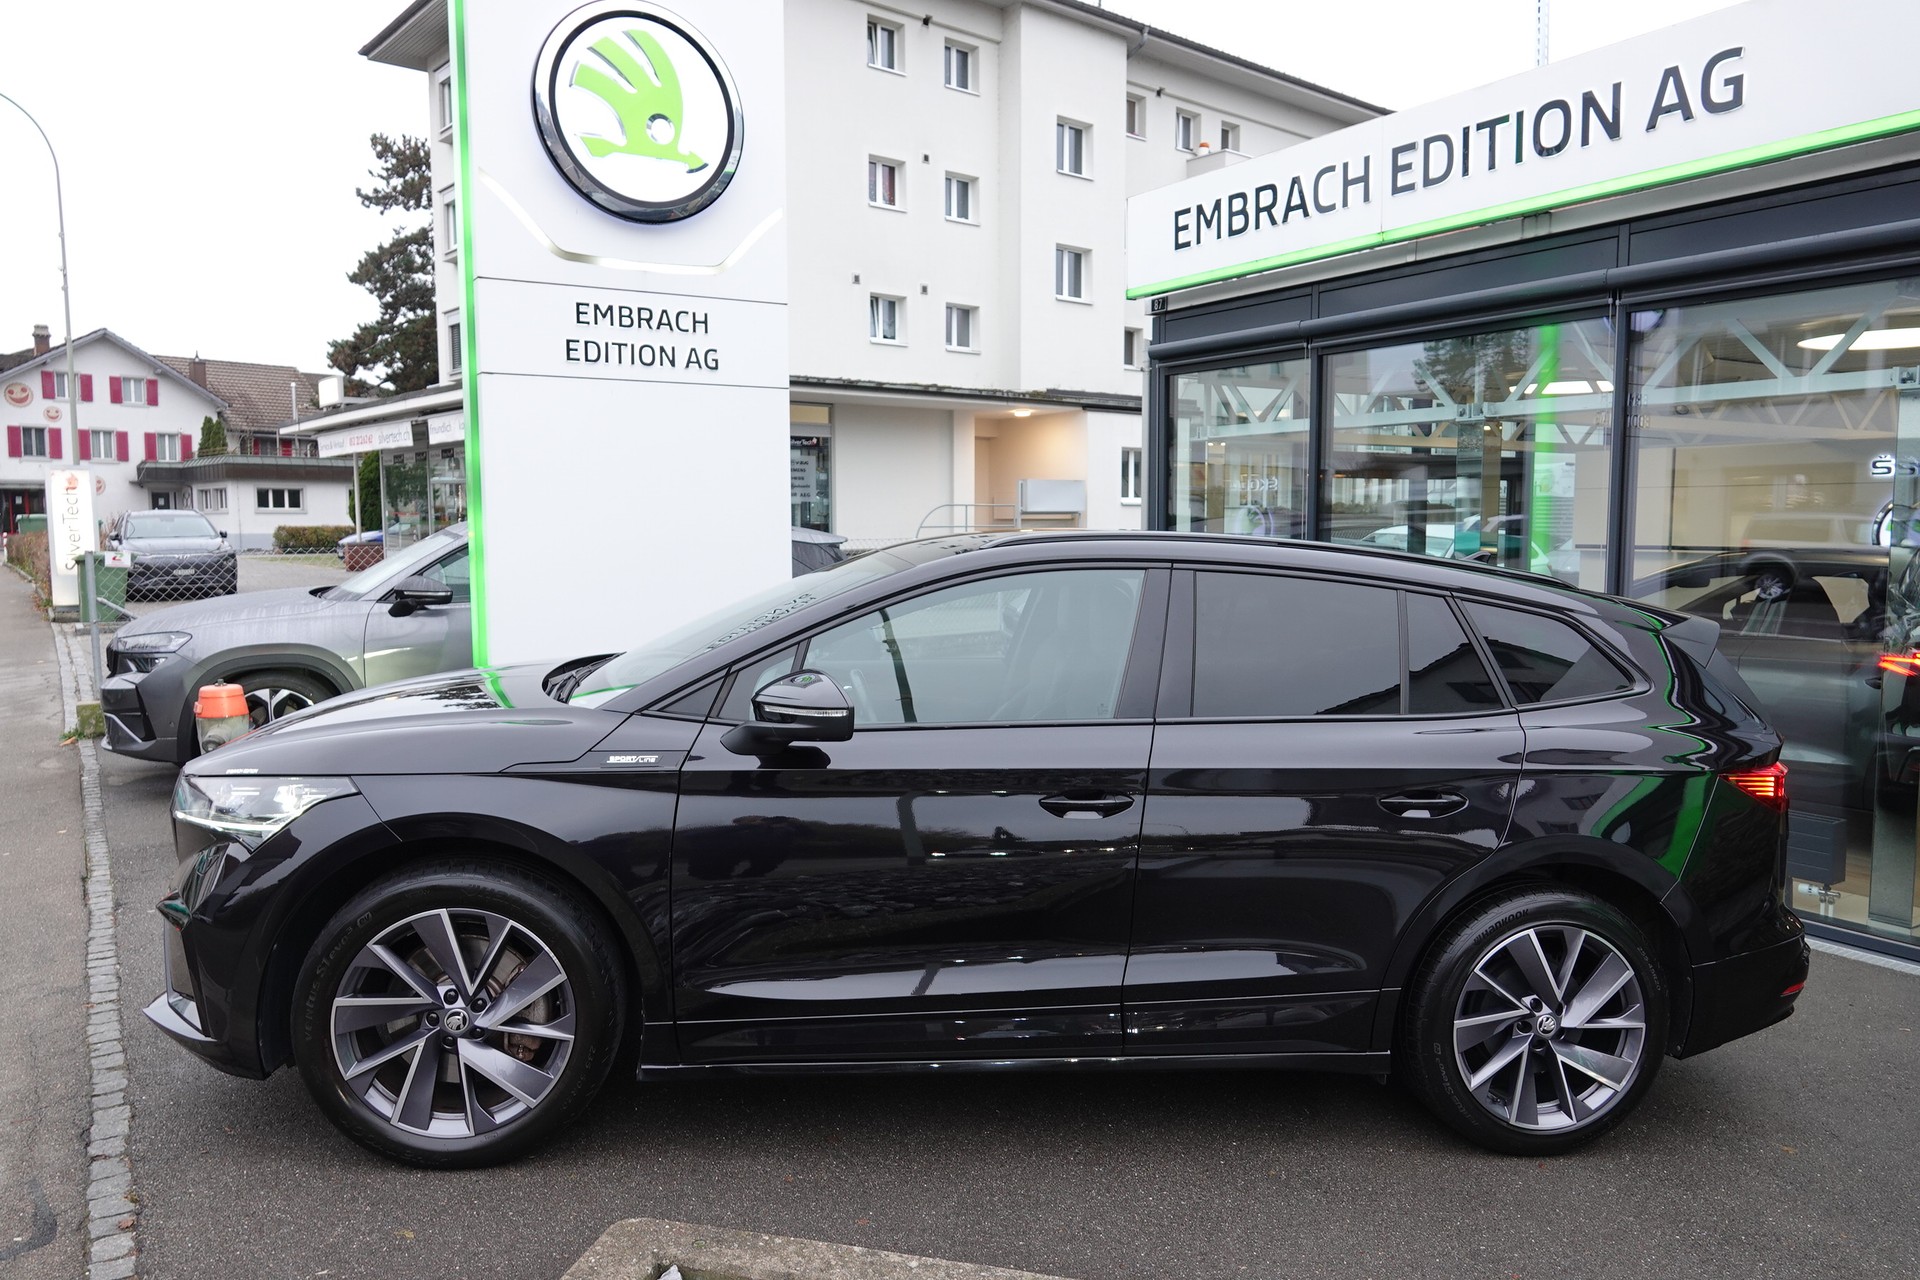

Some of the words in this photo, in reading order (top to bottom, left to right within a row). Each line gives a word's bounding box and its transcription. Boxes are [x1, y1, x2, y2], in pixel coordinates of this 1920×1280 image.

[1173, 154, 1372, 253] EMBRACH
[1390, 81, 1623, 198] EDITION
[1646, 46, 1745, 132] AG
[575, 301, 709, 334] EMBRACH
[1154, 299, 1163, 310] 87
[565, 338, 676, 369] EDITION
[684, 346, 719, 371] AG
